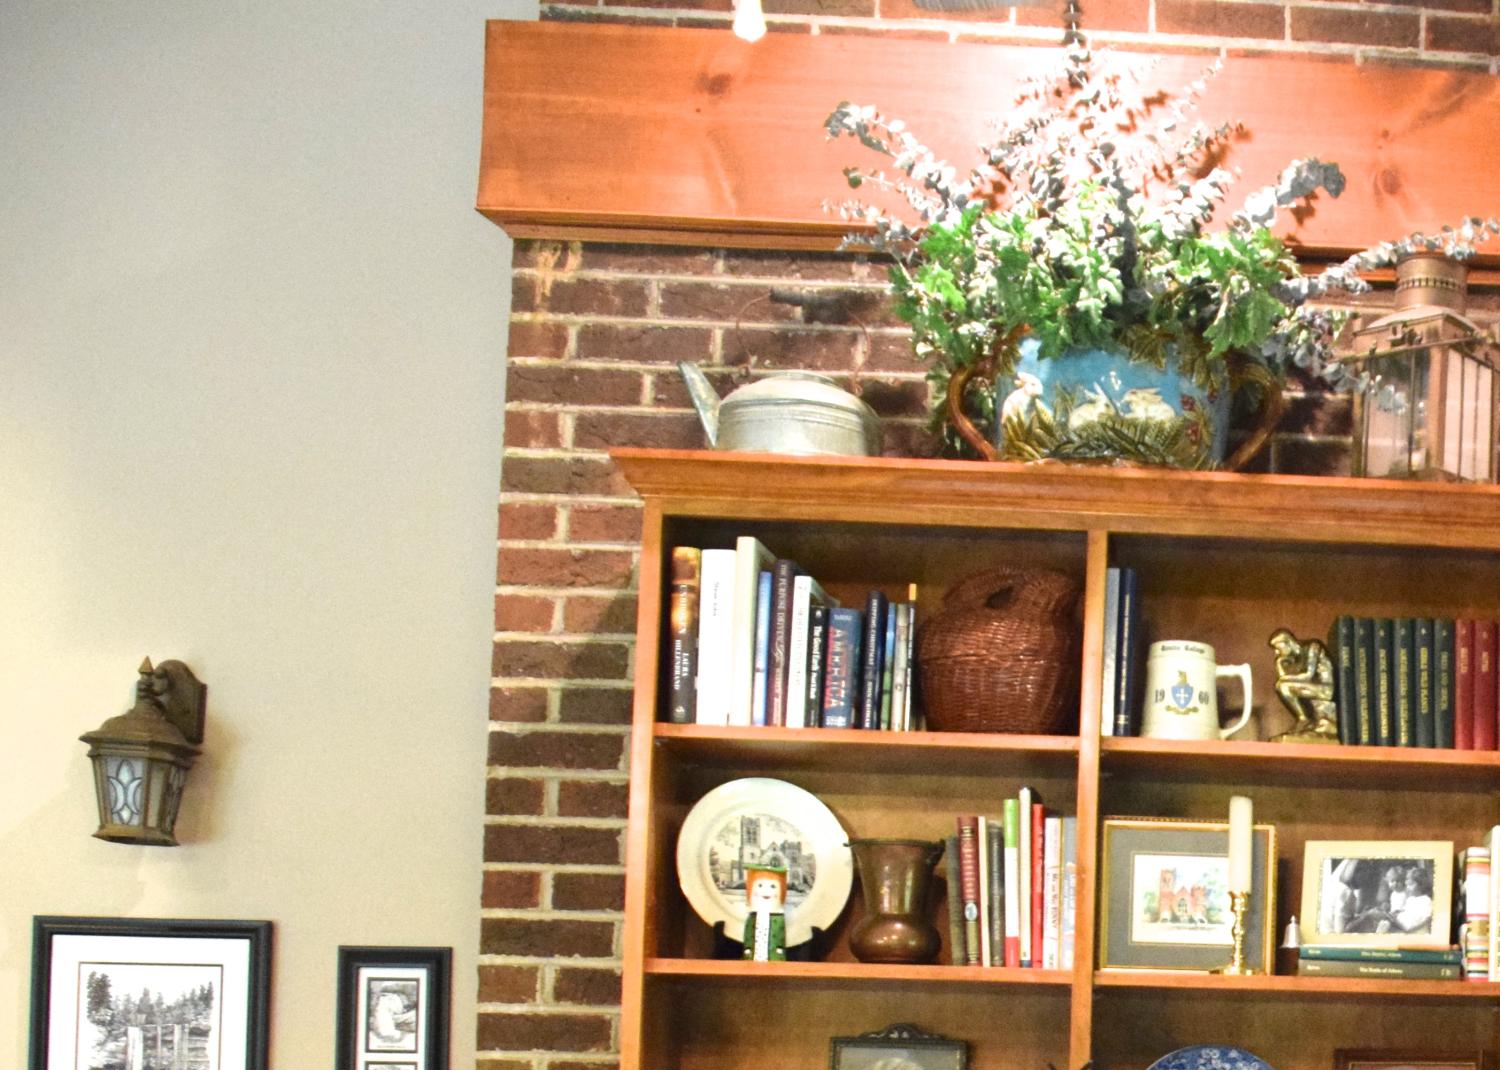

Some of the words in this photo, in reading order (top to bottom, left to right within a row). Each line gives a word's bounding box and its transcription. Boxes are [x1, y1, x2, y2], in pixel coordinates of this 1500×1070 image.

[678, 583, 688, 635] UNBROKEN
[813, 625, 822, 636] The
[812, 637, 822, 654] Good
[673, 639, 682, 690] HILLENBRAND
[681, 652, 690, 677] LAURA
[811, 655, 821, 671] Earth
[828, 627, 847, 708] AMERICA
[1154, 688, 1166, 703] 19
